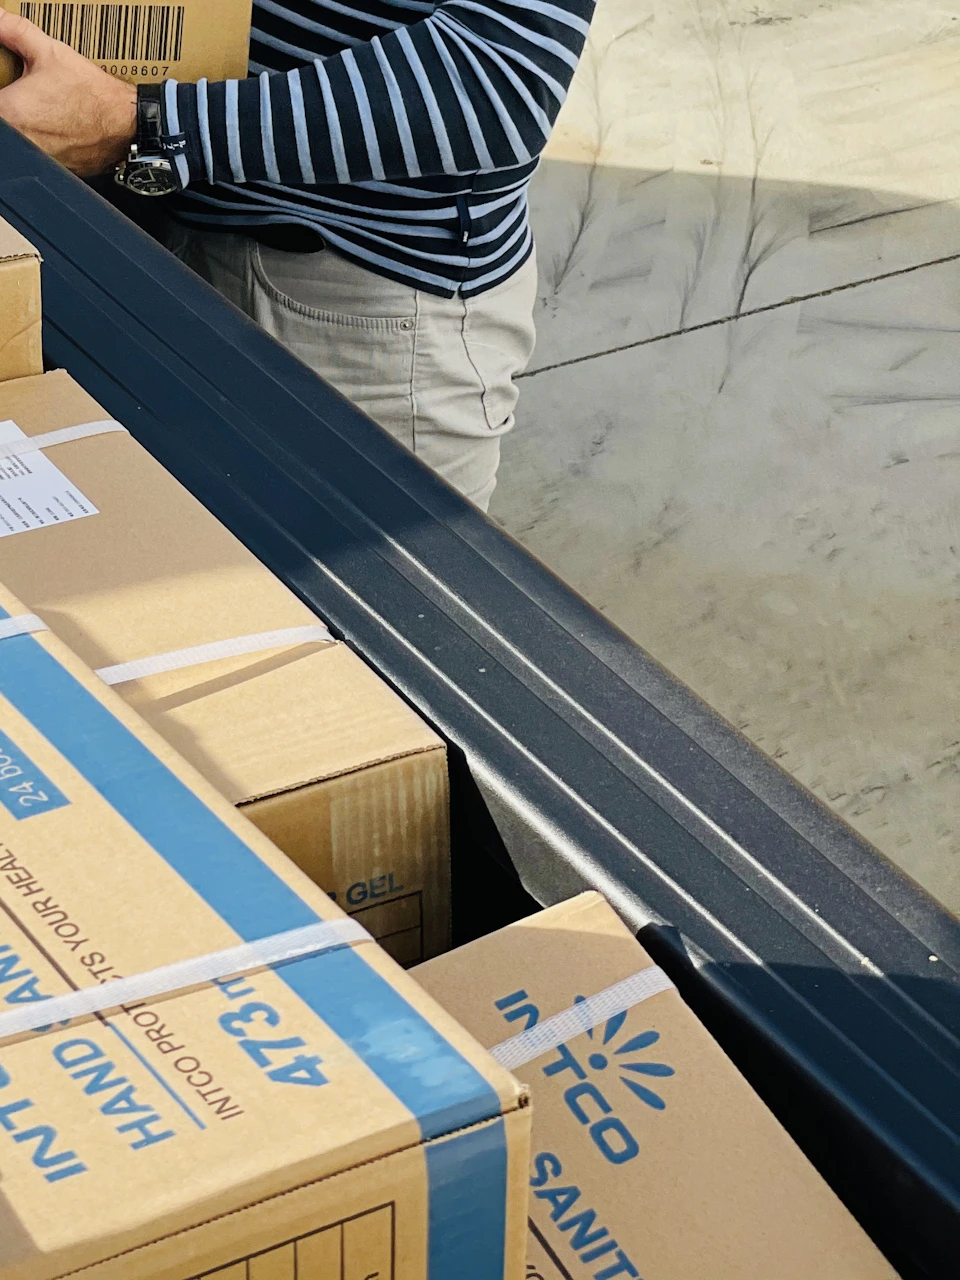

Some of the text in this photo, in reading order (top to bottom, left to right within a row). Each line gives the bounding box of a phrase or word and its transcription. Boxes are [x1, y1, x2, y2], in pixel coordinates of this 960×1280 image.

[8, 780, 49, 807] 24
[345, 872, 405, 906] GEL
[32, 896, 89, 952] YOUR
[217, 1001, 330, 1087] 473
[52, 1037, 177, 1151] HAND
[173, 1055, 246, 1121] INTCO
